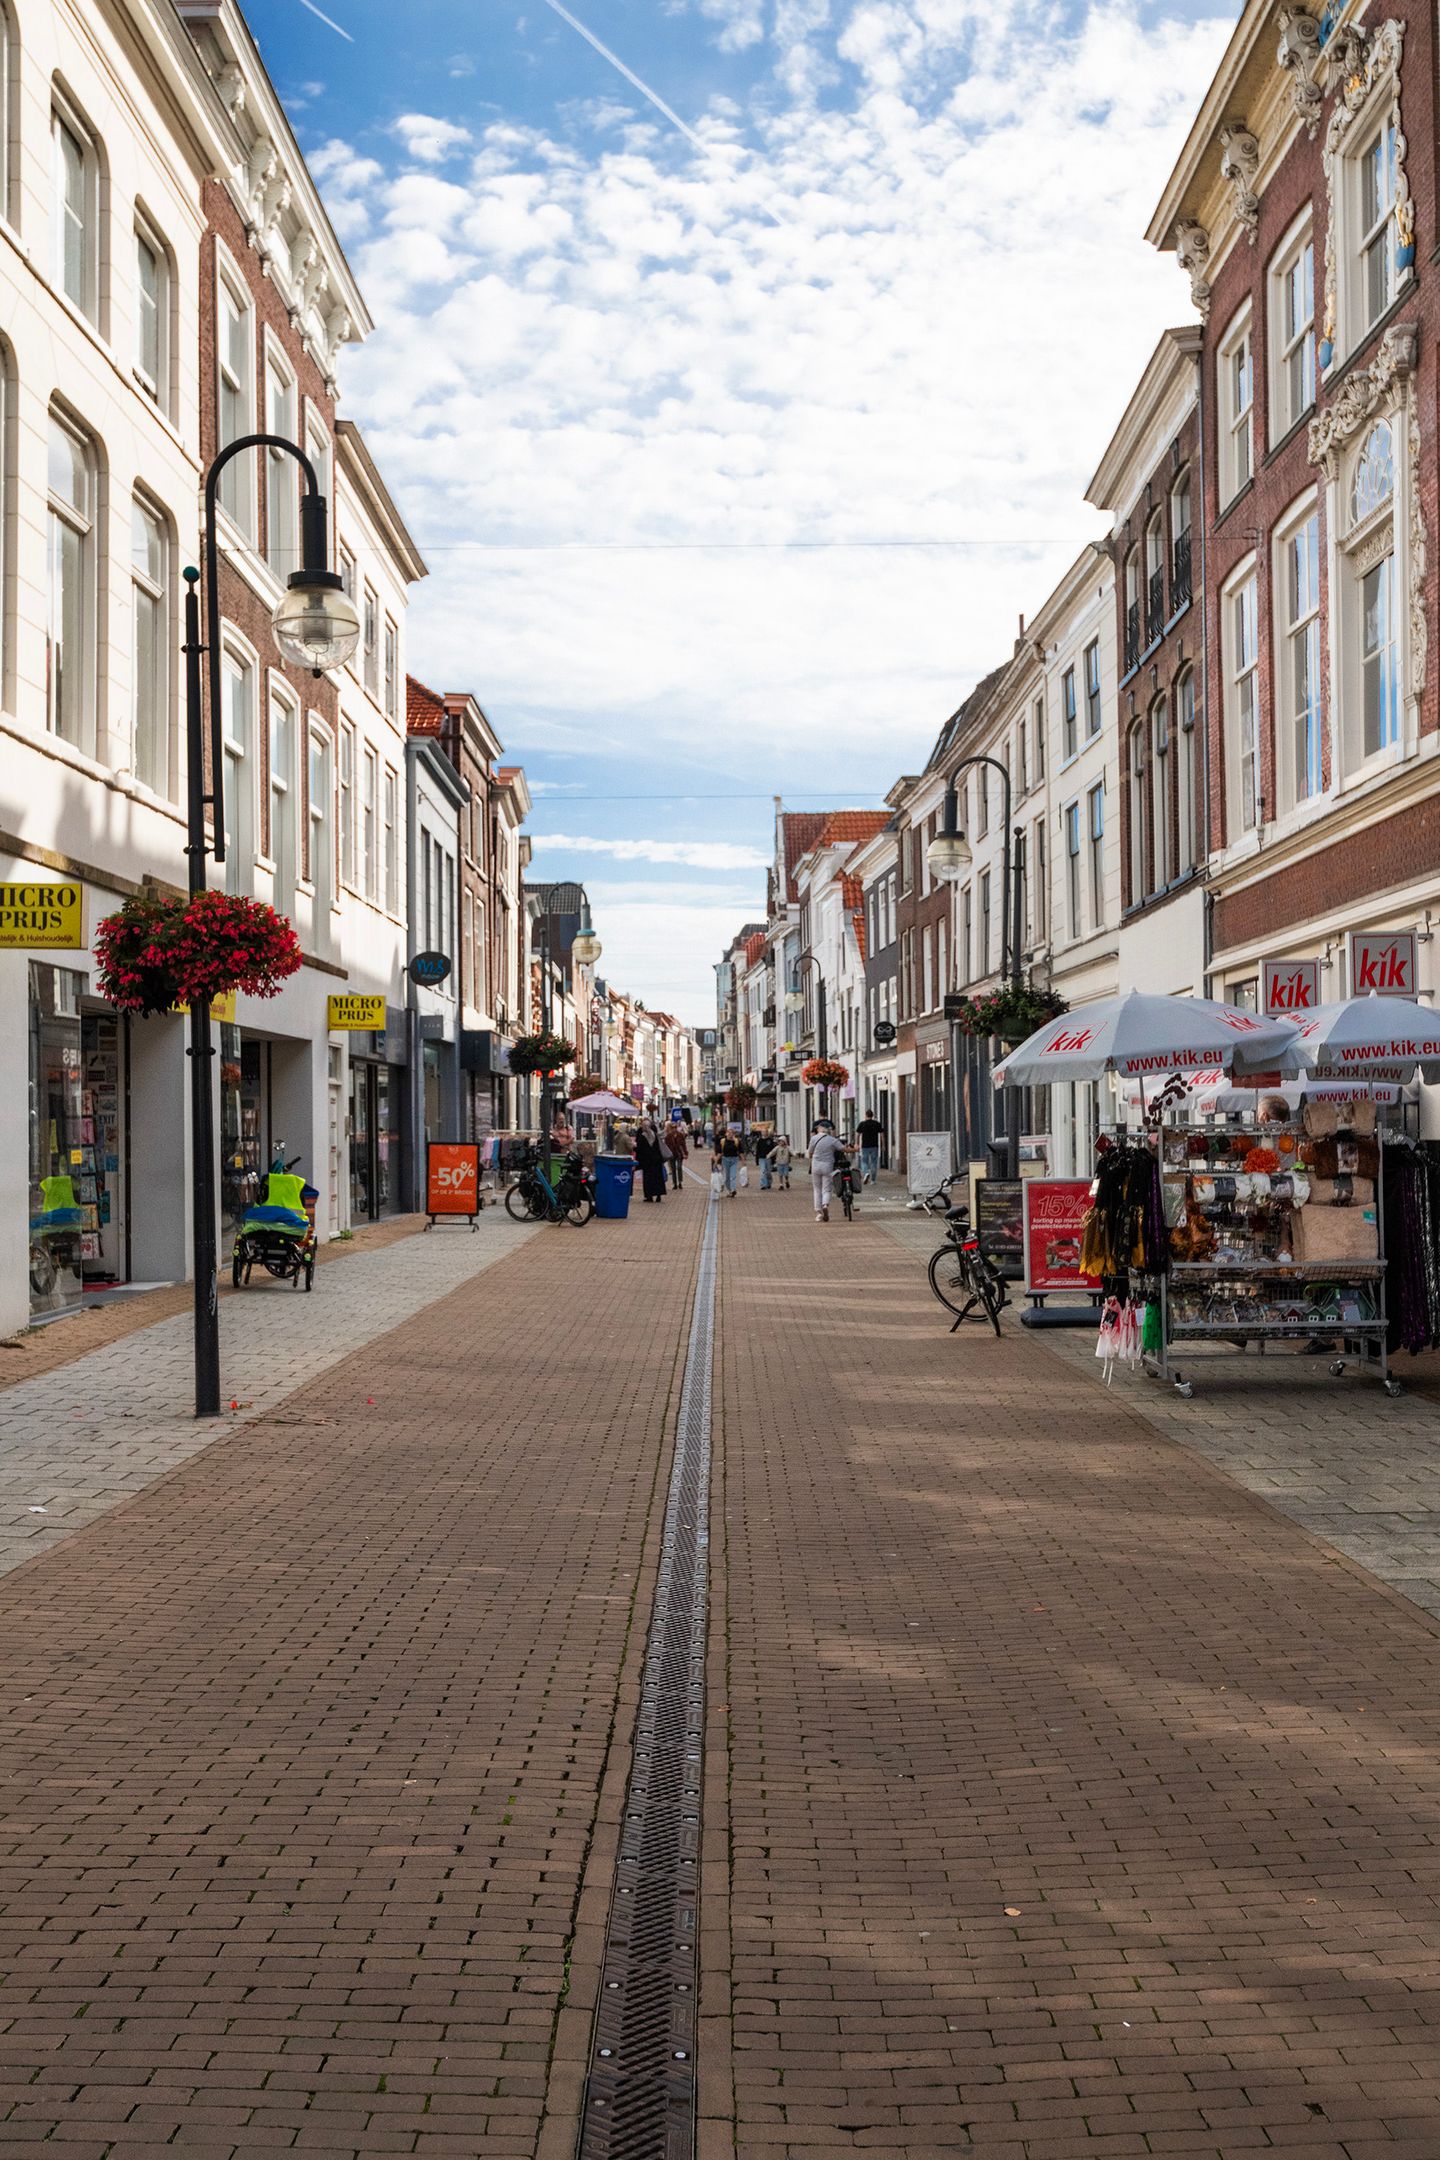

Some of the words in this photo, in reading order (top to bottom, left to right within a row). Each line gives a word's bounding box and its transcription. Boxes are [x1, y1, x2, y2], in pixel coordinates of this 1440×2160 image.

[0, 887, 77, 908] ICRO
[0, 911, 63, 931] PRIJS
[1360, 940, 1408, 987] kik
[1270, 968, 1312, 1008] kik
[332, 997, 382, 1009] MICRO
[338, 1010, 374, 1021] PRIJS
[1046, 1029, 1093, 1052] kik
[1341, 1039, 1440, 1061] www.kik.eu
[1126, 1050, 1223, 1072] www.kik.eu
[431, 1161, 475, 1189] -50%
[1038, 1194, 1088, 1217] 15%
